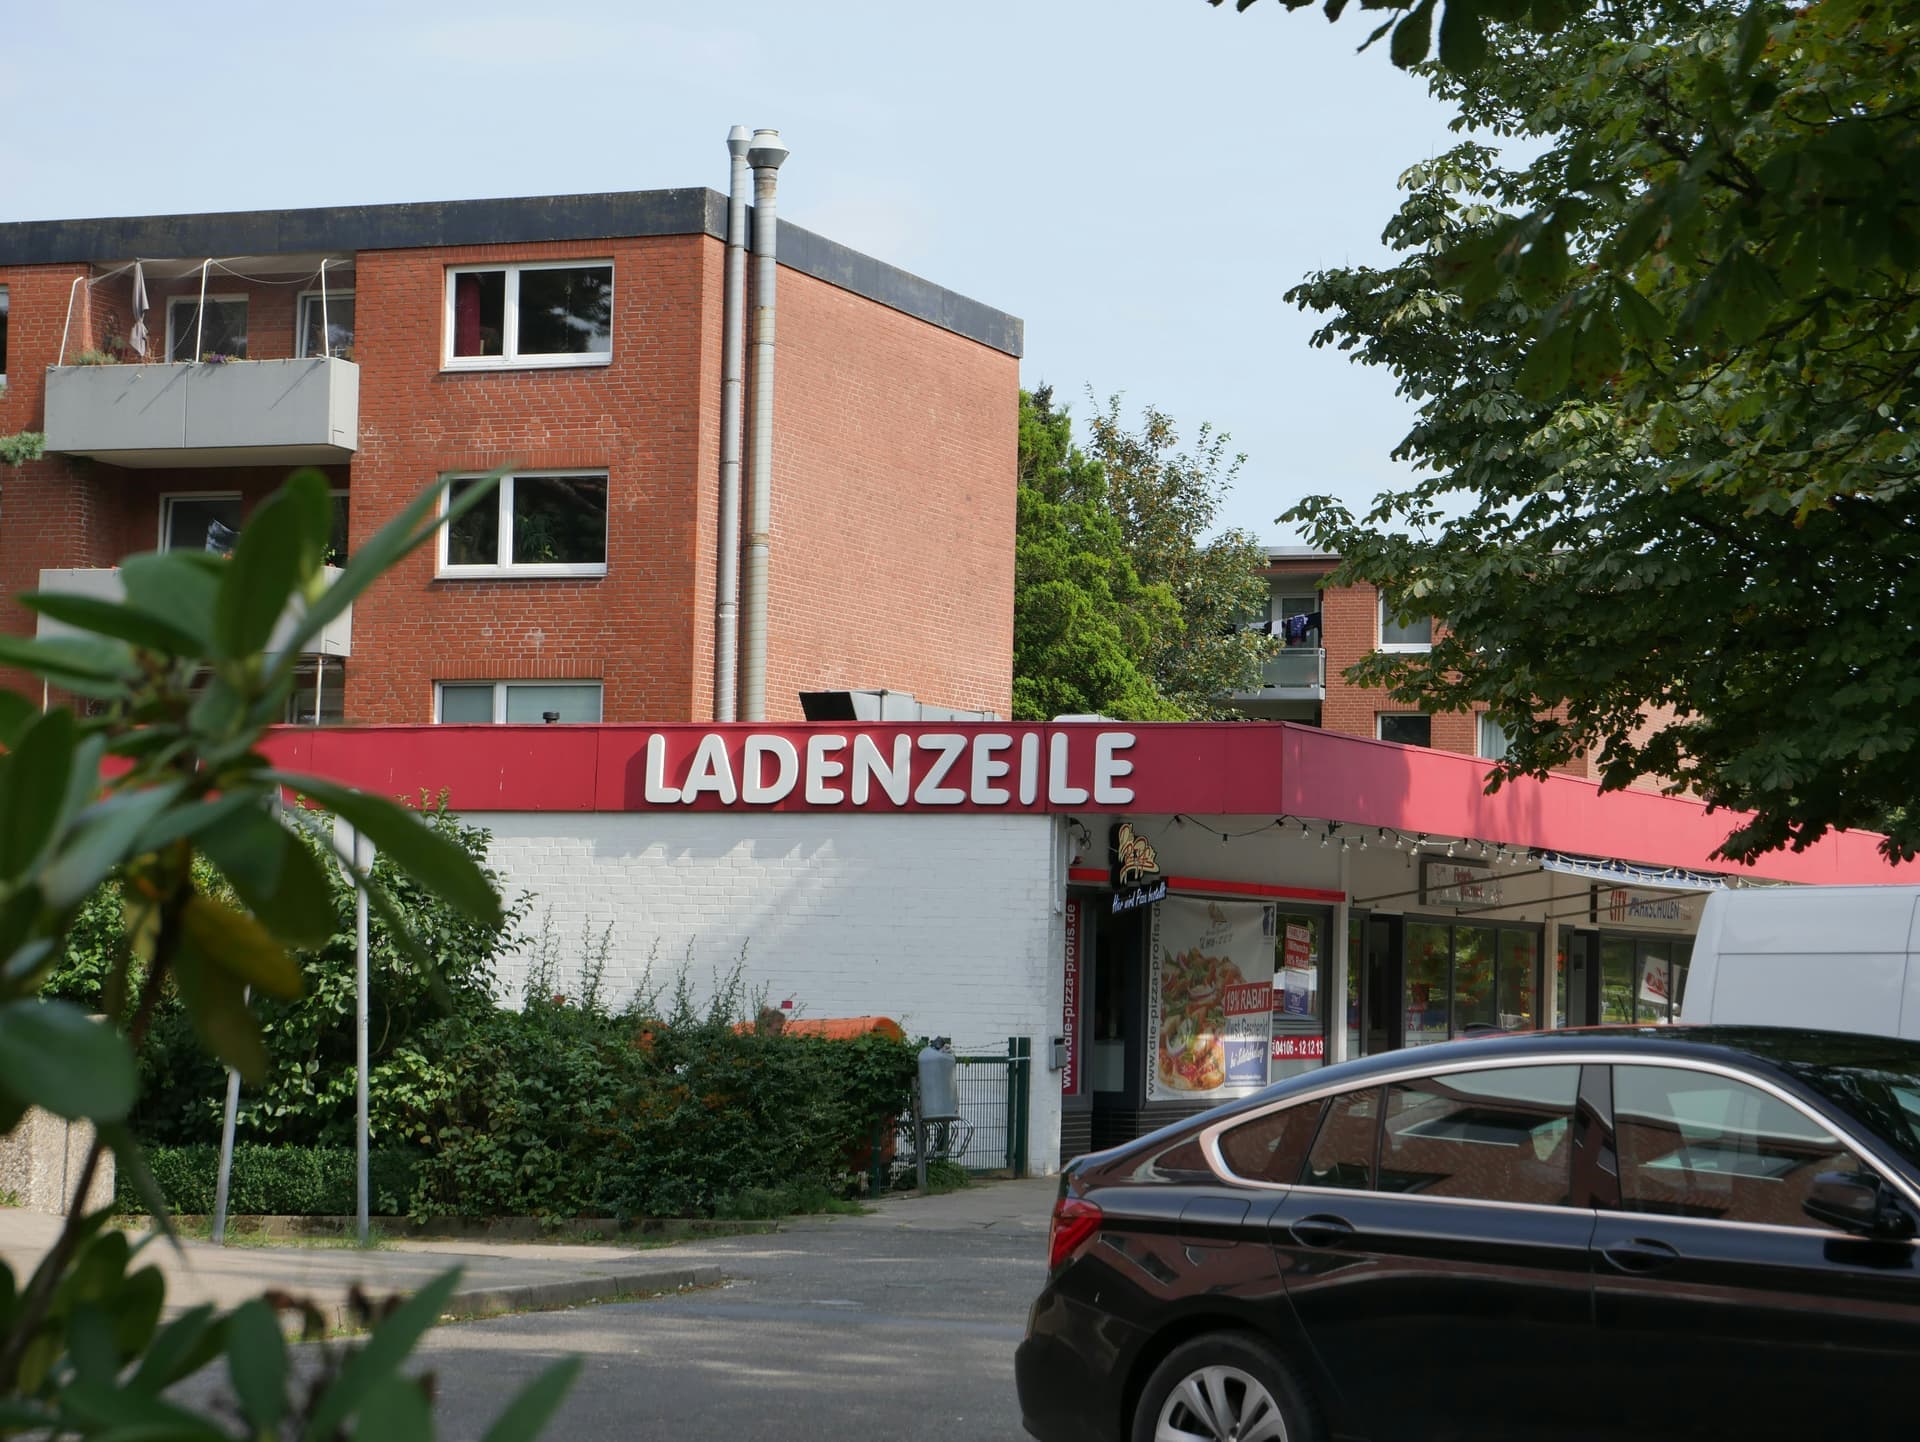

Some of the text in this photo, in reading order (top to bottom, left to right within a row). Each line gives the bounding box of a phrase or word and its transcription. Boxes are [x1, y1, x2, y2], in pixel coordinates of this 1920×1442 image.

[644, 732, 1137, 806] LADENZEILE
[1610, 889, 1627, 922] CITY
[1226, 990, 1240, 1012] 19%
[1241, 987, 1270, 1010] RABATT
[1275, 1040, 1294, 1055] 04106
[1299, 1039, 1306, 1055] 12
[1307, 1039, 1315, 1055] 12
[1316, 1039, 1324, 1055] 13
